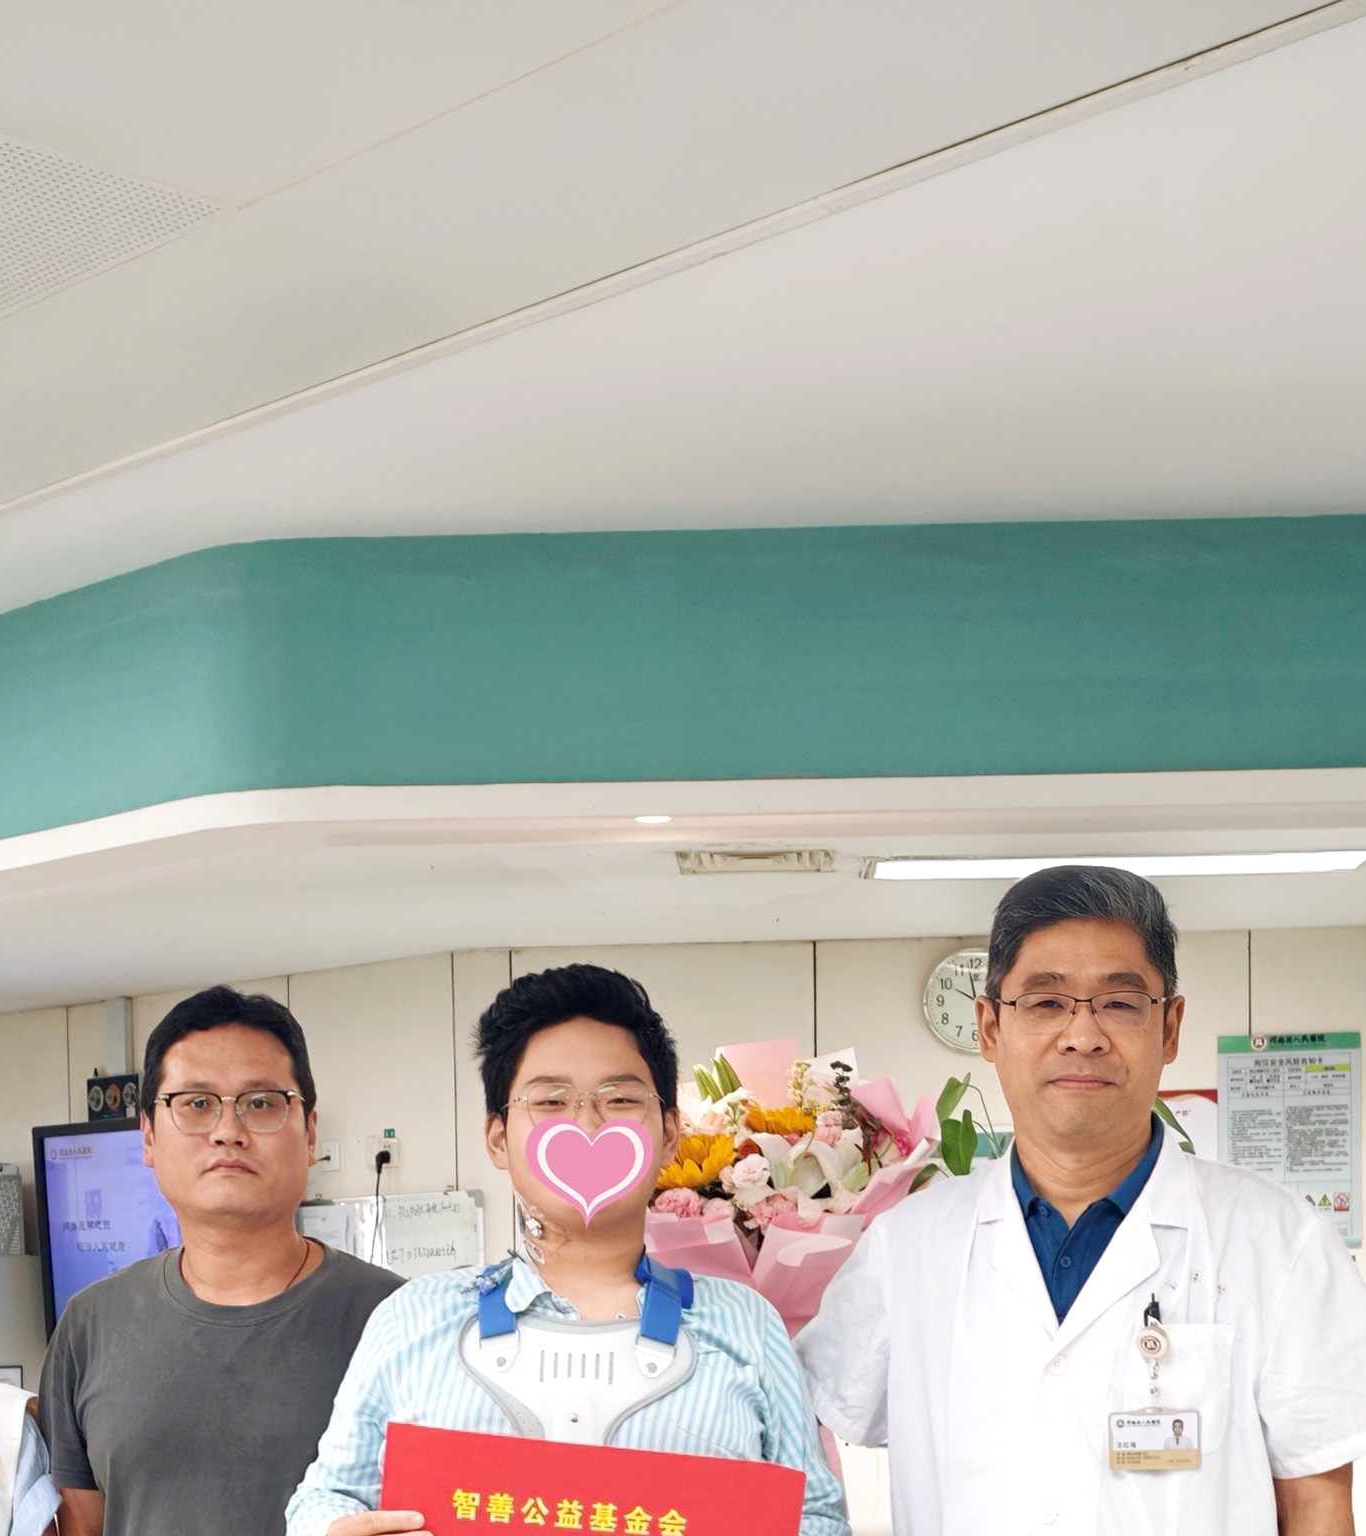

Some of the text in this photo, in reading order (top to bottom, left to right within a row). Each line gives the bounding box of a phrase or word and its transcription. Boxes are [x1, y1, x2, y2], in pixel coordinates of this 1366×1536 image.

[969, 957, 982, 970] 12
[940, 977, 953, 990] 10
[936, 995, 944, 1007] 9
[941, 1012, 949, 1025] 8
[955, 1025, 963, 1038] 7
[971, 1029, 979, 1042] 6
